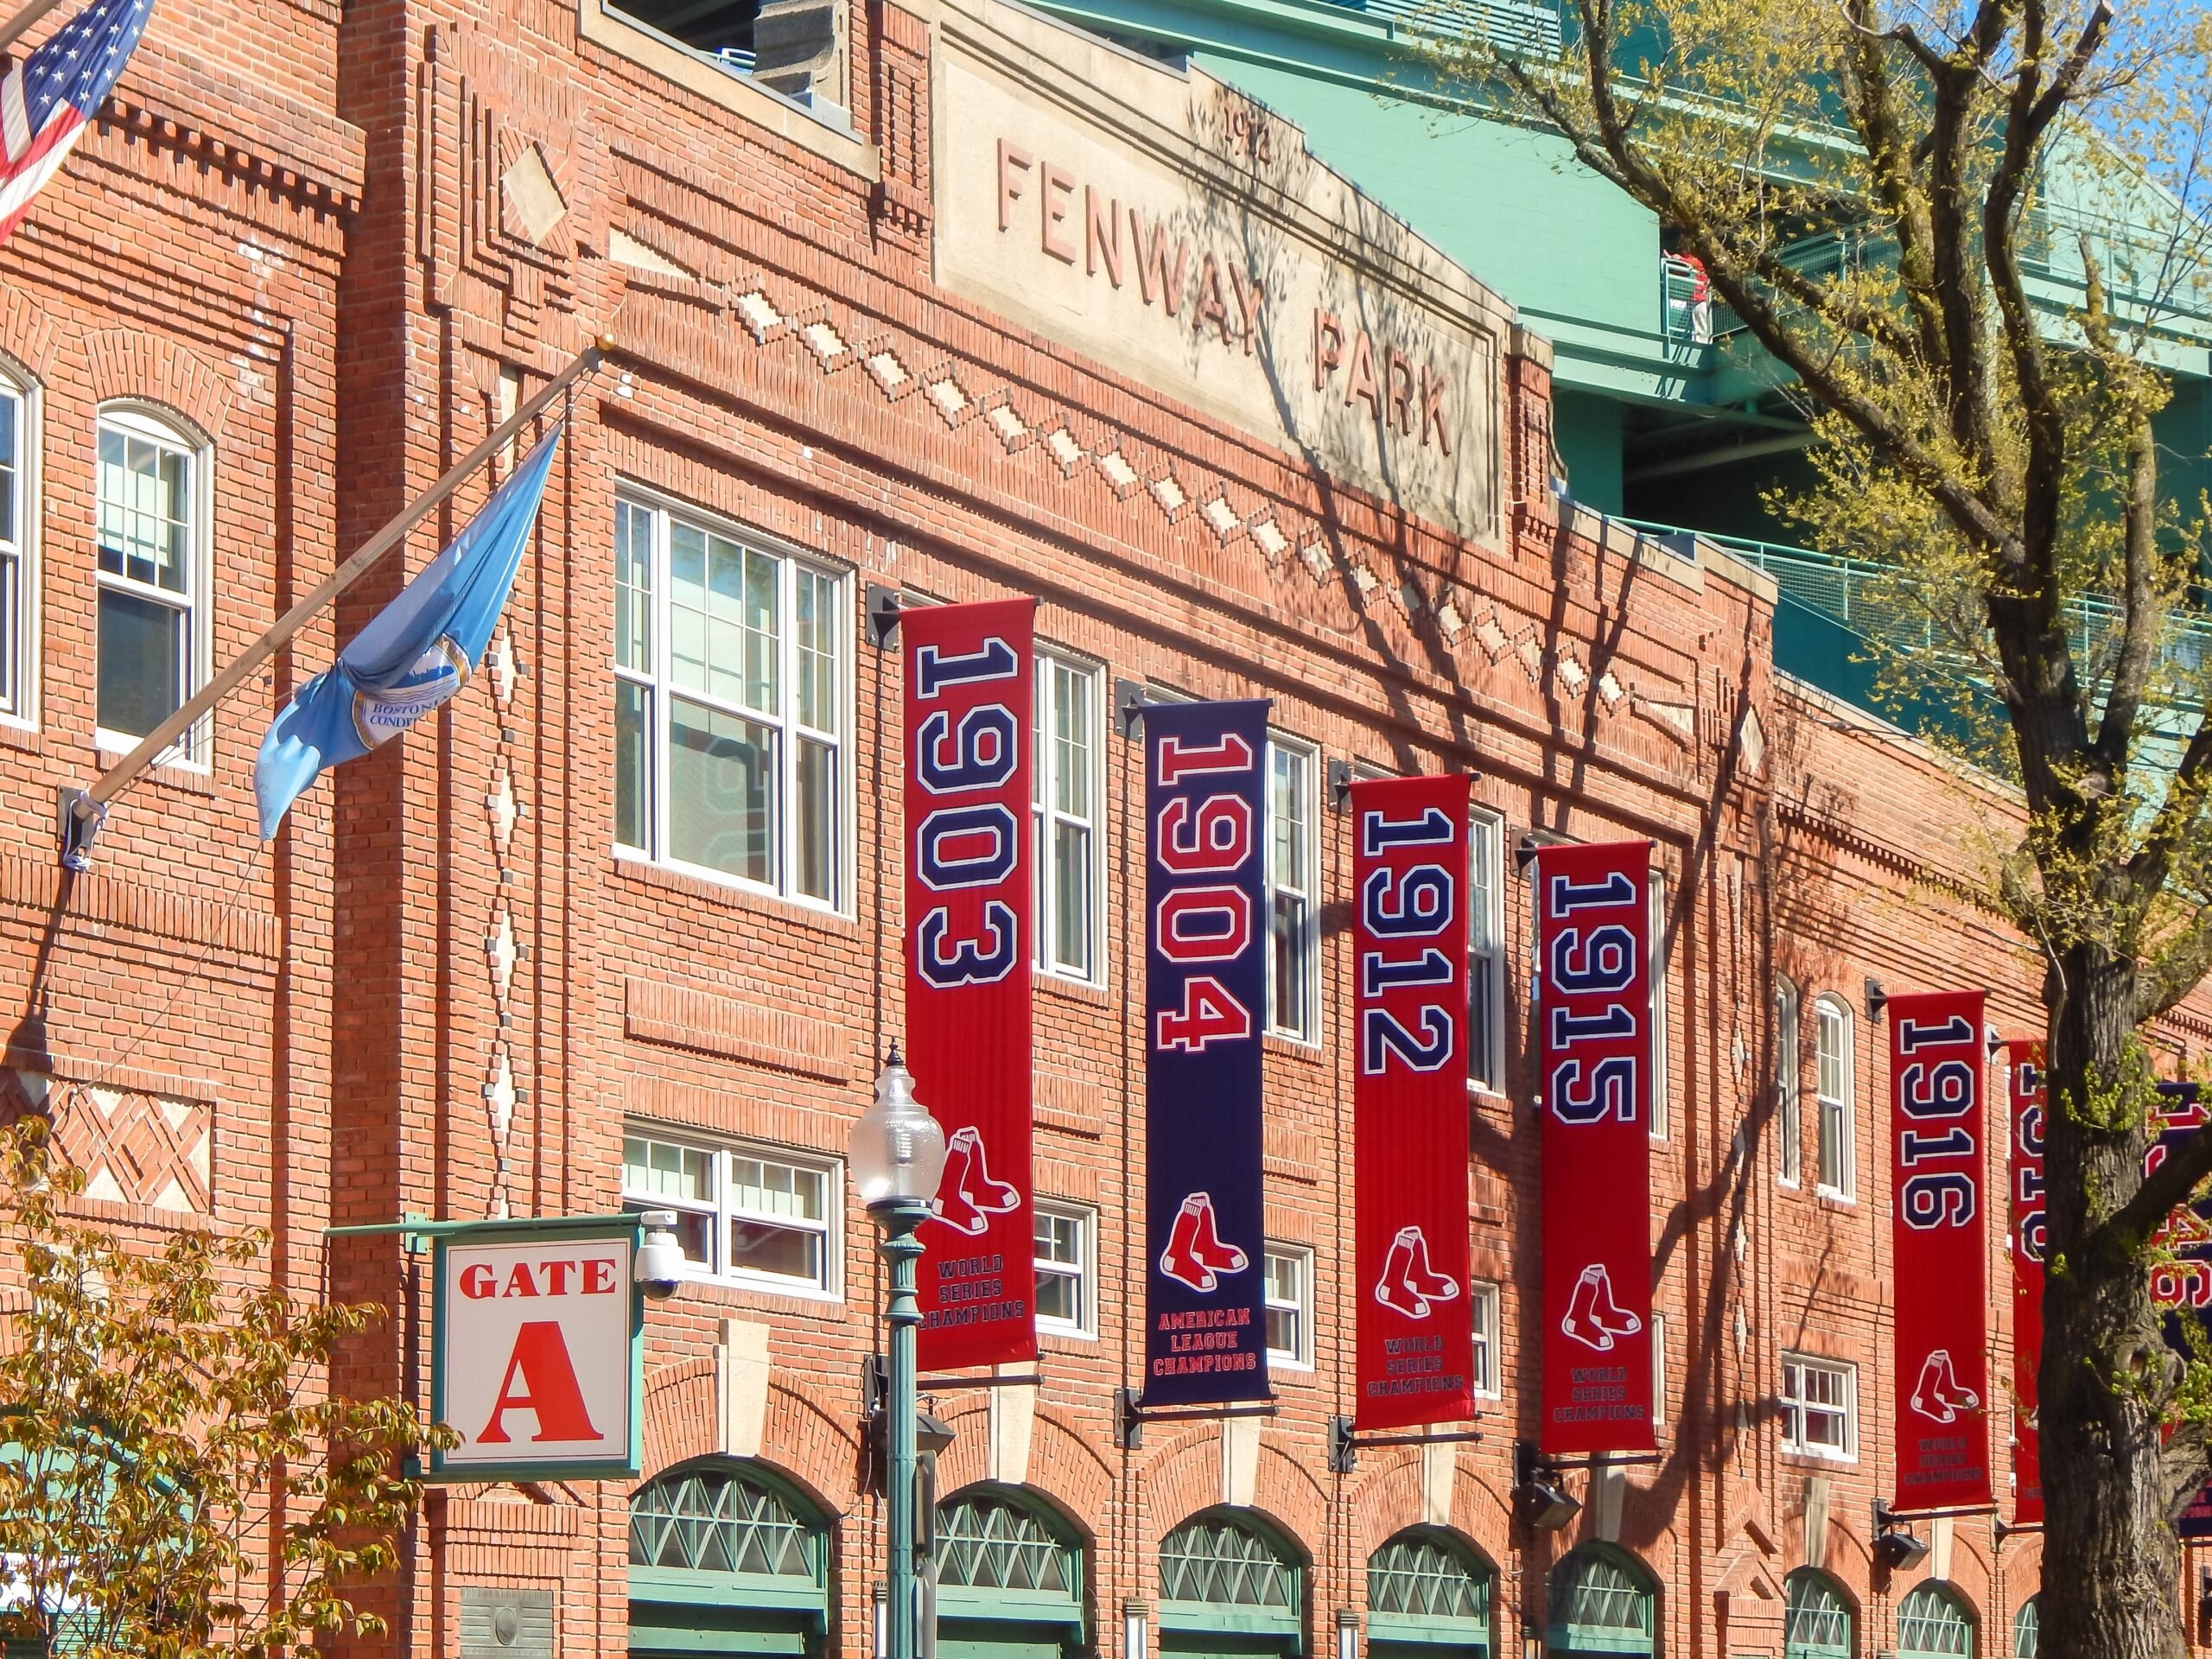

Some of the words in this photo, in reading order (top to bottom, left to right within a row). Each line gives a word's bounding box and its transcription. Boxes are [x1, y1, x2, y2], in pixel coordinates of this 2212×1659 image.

[997, 137, 1264, 356] FENWAY
[1313, 307, 1452, 457] PARK
[917, 637, 1019, 989] 1903
[1156, 733, 1254, 1052] 1904
[1363, 806, 1455, 1075] 1912
[1551, 871, 1637, 1124] 1915
[1899, 1014, 1975, 1230] 1916
[459, 1258, 618, 1300] GATE
[937, 1254, 1004, 1280] WORLD
[938, 1278, 1002, 1304] SERIES
[918, 1300, 1025, 1331] CHAMPIONS
[1158, 1307, 1251, 1331] AMERICAN
[1170, 1331, 1238, 1352] LEAGUE
[1384, 1335, 1444, 1355] WORLD
[1153, 1352, 1257, 1376] CHAMPIONS
[1386, 1355, 1444, 1376] SERIES
[1570, 1367, 1628, 1383] WORLD
[476, 1320, 605, 1444] A
[1367, 1374, 1464, 1397] CHAMPIONS
[1572, 1385, 1626, 1402] SERIES
[1553, 1404, 1645, 1423] CHAMPIONS
